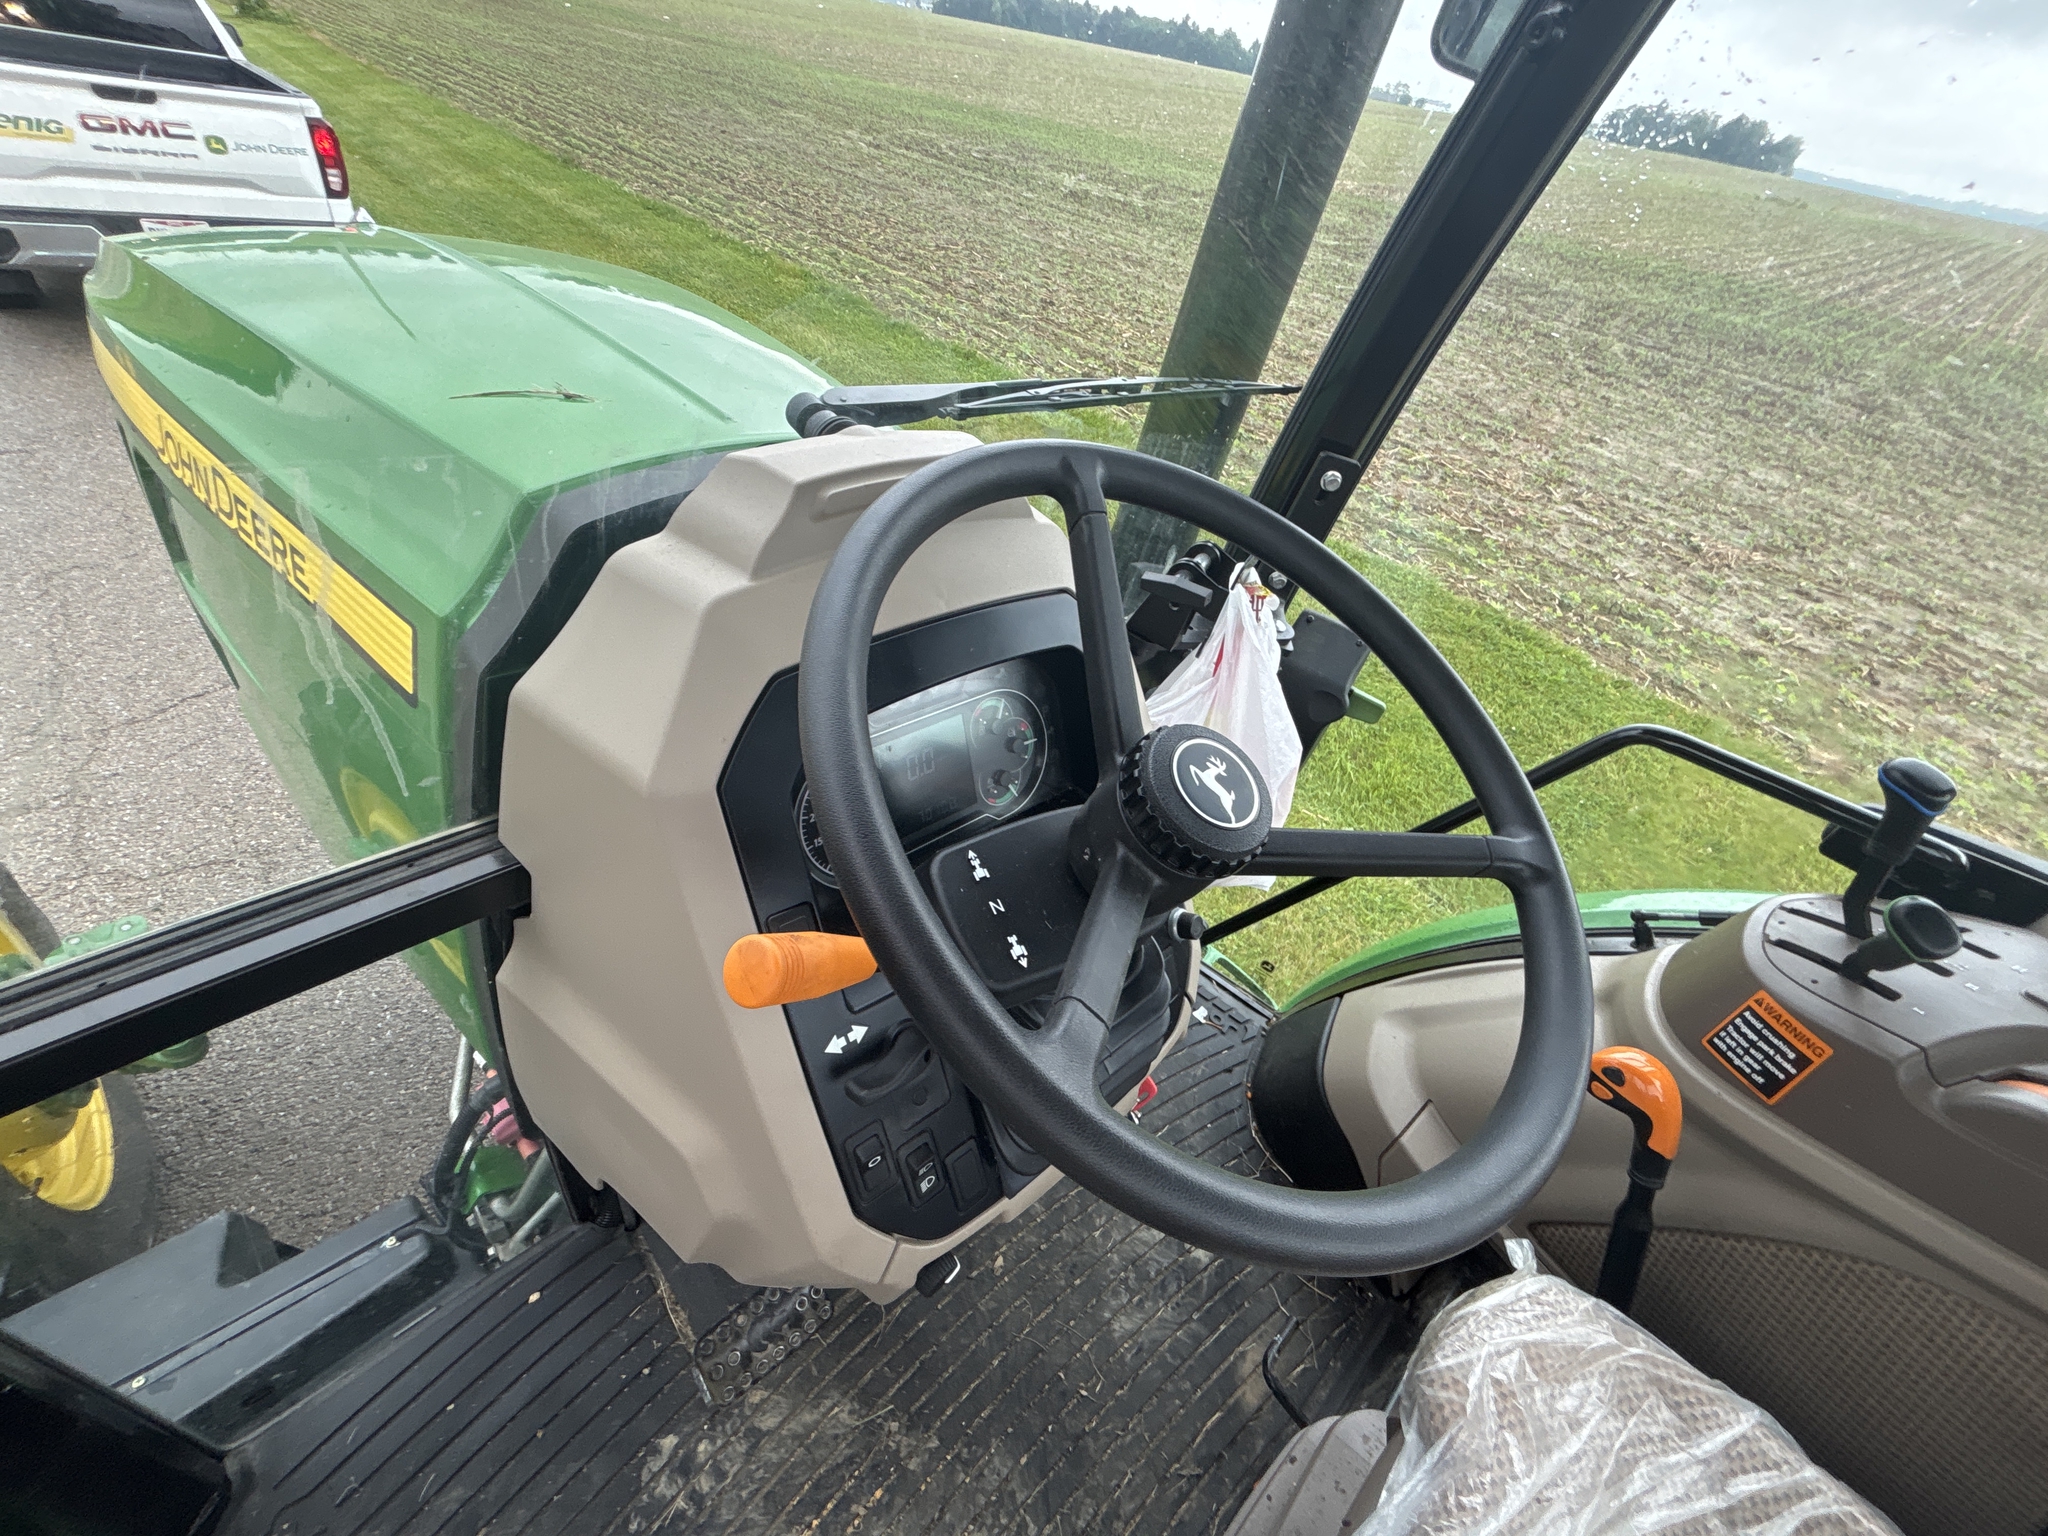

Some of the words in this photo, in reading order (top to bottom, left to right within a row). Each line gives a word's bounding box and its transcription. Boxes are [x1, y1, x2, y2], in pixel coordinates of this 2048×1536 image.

[78, 113, 196, 141] GMC
[232, 141, 267, 154] JOHN
[267, 143, 308, 157] DEERE
[988, 898, 1006, 915] N
[1724, 1035, 1737, 1049] left
[1742, 1054, 1762, 1071] gear
[1726, 1024, 1750, 1049] Tractor
[1749, 1047, 1764, 1061] will
[1762, 1059, 1786, 1080] move
[1734, 1017, 1759, 1042] Engage
[1756, 1040, 1775, 1057] park
[1774, 1053, 1798, 1075] brake
[1743, 1010, 1764, 1030] Avoid
[1761, 1028, 1797, 1060] crushing
[1763, 1002, 1825, 1058] WARNING
[1713, 1036, 1727, 1052] with
[1726, 1050, 1752, 1074] engine
[1751, 1073, 1766, 1084] off
